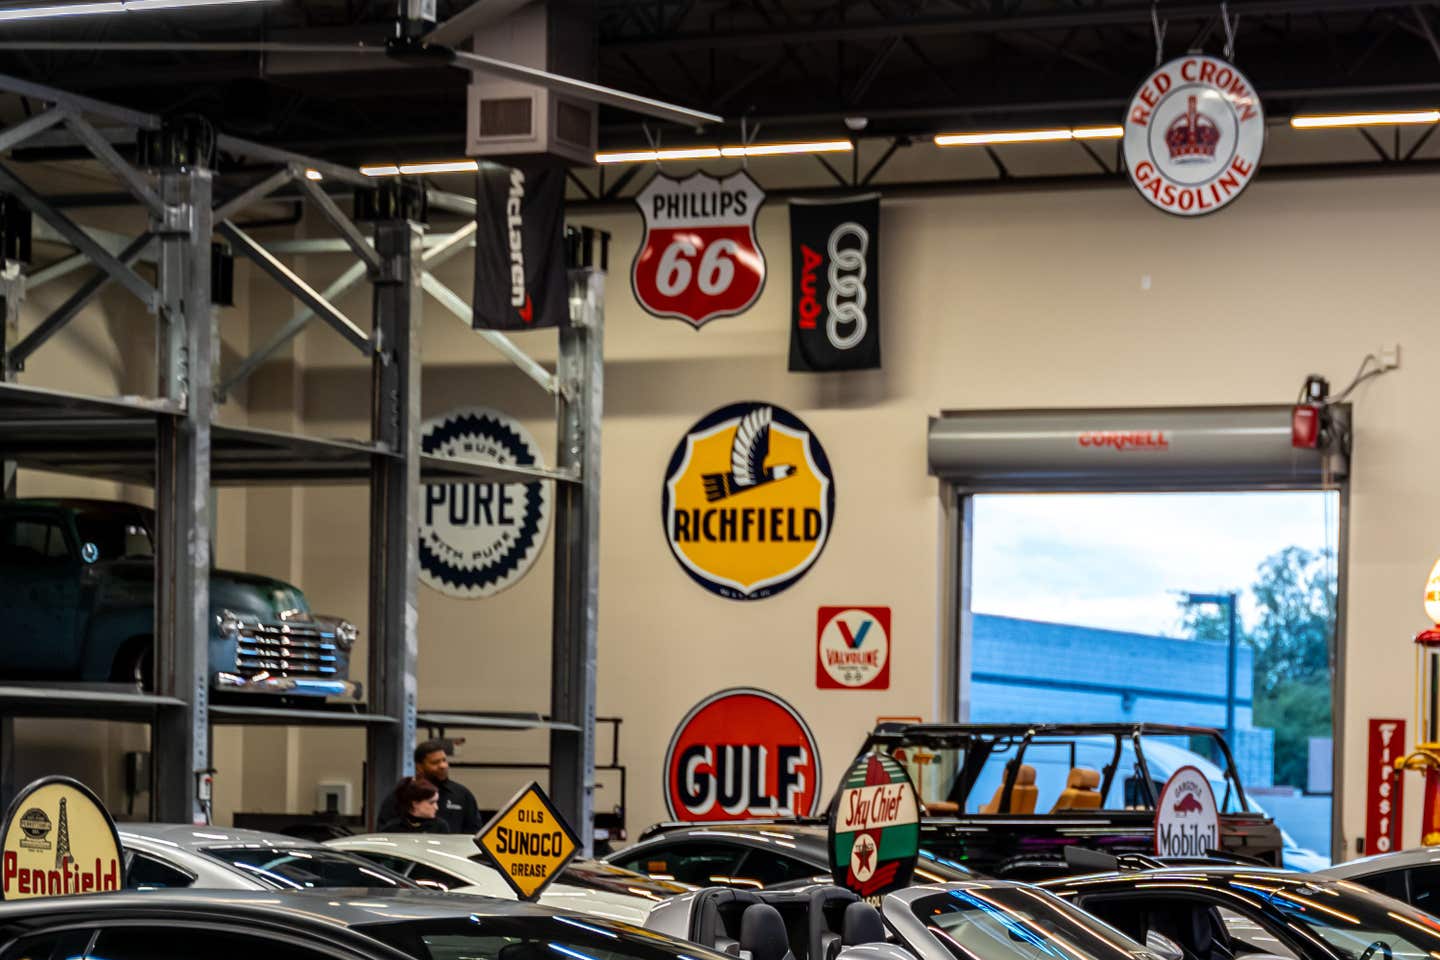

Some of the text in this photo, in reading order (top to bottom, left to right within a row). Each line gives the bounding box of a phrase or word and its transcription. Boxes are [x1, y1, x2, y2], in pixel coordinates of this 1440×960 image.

[1130, 59, 1258, 127] RED CROWN
[1135, 155, 1253, 211] GASOLINE
[652, 191, 749, 221] PHILLIPS
[507, 168, 526, 307] McLaren
[655, 238, 738, 297] 66
[799, 244, 823, 330] Audi
[425, 482, 515, 527] PURE
[673, 507, 822, 543] RICHFIELD
[825, 648, 879, 668] VALVOLINE
[677, 743, 809, 817] GULF
[518, 809, 544, 824] OILS
[845, 784, 905, 830] Sky Chief
[495, 826, 562, 858] SUNOCO
[1160, 823, 1216, 857] Mobiloil
[3, 850, 117, 895] Pennfield
[511, 863, 547, 878] GREASE
